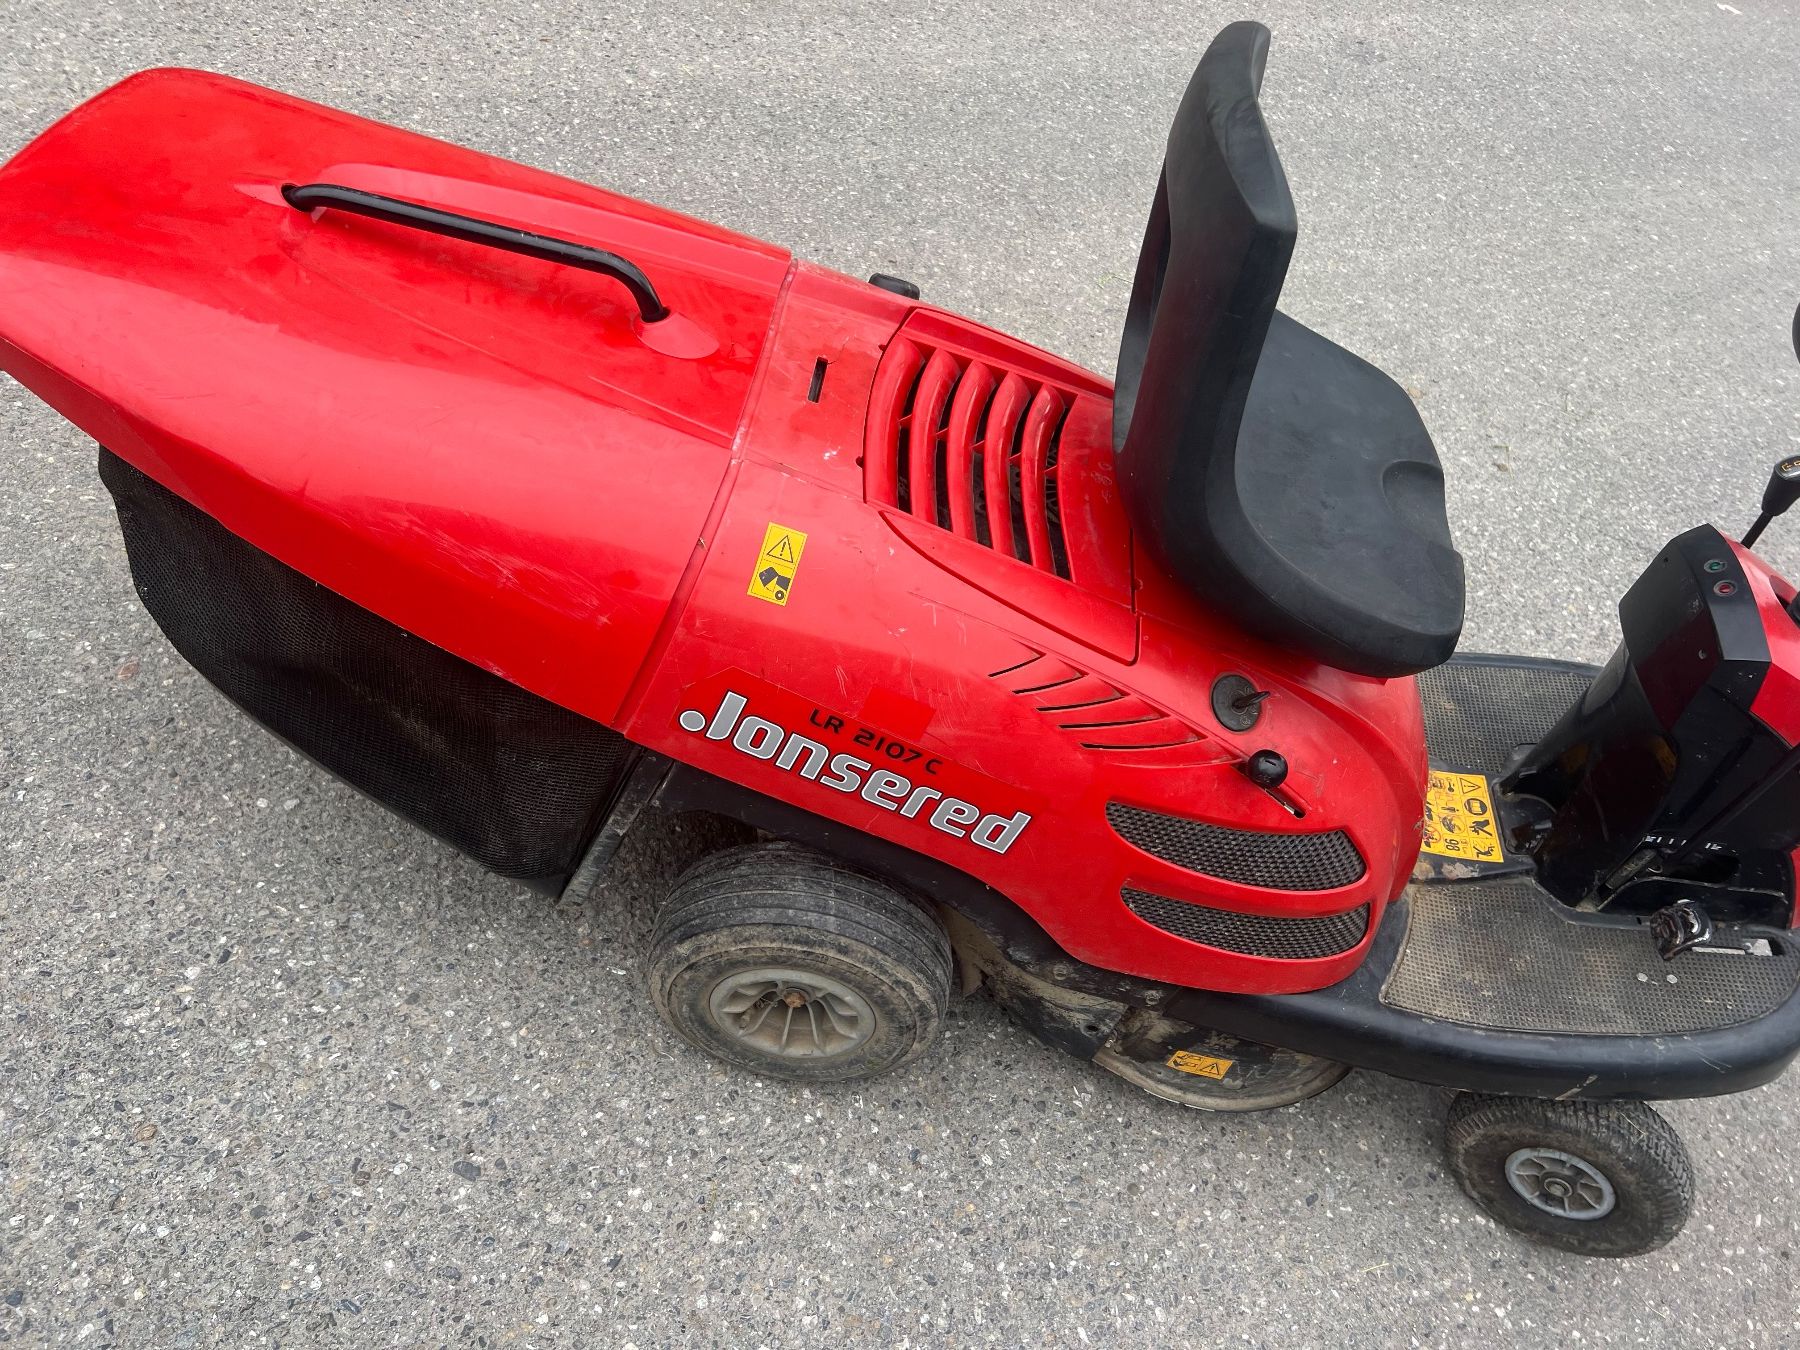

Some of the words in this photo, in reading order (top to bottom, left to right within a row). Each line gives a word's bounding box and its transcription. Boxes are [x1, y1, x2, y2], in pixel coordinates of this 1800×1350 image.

[704, 689, 1032, 855] Jonsered
[809, 708, 845, 734] LR
[852, 728, 923, 763] 2107
[924, 758, 943, 775] C
